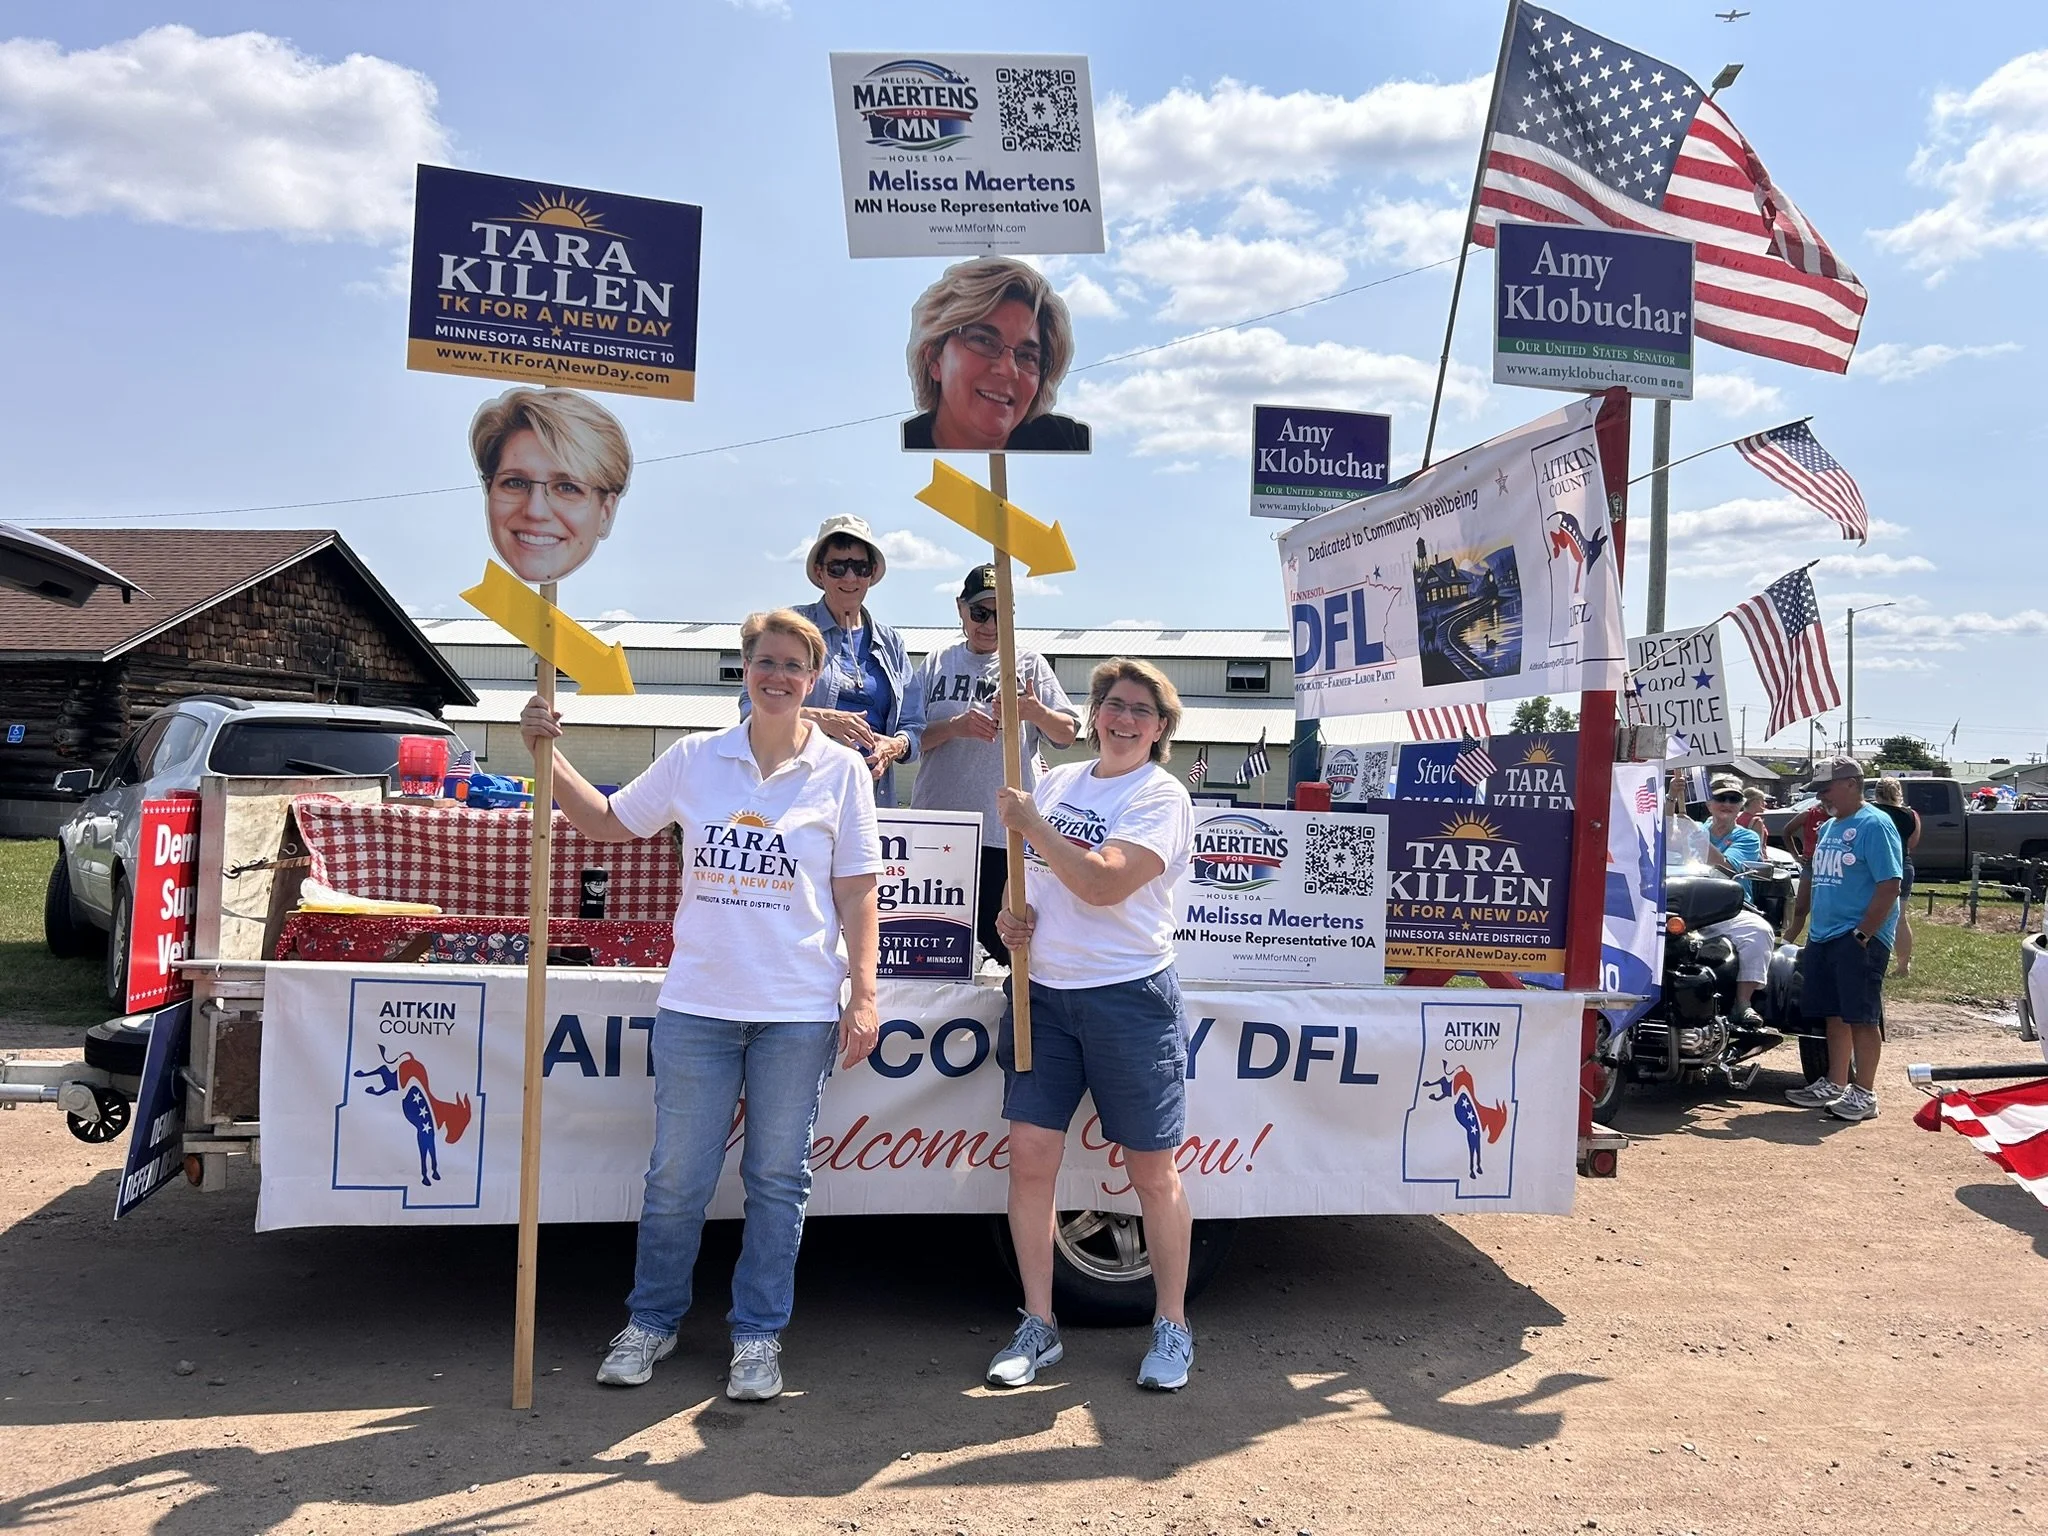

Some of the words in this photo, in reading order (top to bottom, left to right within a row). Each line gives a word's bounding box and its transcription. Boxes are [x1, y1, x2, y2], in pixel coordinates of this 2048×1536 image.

[881, 77, 924, 85] MELISSA
[853, 84, 979, 110] MAERTENS
[897, 118, 941, 139] MN
[869, 169, 958, 192] Melissa
[965, 170, 1075, 192] Maertens
[854, 199, 883, 213] MN
[887, 199, 937, 213] House
[941, 199, 1059, 216] Representative
[1062, 199, 1092, 213] 10A
[929, 223, 1027, 234] www.MMforMN.com
[472, 222, 637, 274] TARA
[1531, 241, 1613, 292] Amy
[438, 254, 674, 317] KILLEN
[438, 294, 470, 313] TK
[480, 299, 528, 320] FOR
[537, 308, 552, 322] A
[563, 310, 617, 331] NEW
[627, 318, 672, 337] DAY
[1504, 284, 1687, 335] Klobuchar
[435, 325, 527, 346] MINNESOTA
[532, 336, 589, 354] SENATE
[593, 343, 657, 362] DISTRICT
[661, 352, 674, 363] 10
[1516, 340, 1540, 354] OUR
[1545, 342, 1586, 356] UNITED
[1592, 346, 1628, 360] STATES
[1633, 350, 1675, 366] SENATOR
[437, 347, 670, 384] www.TKForANewDay.com
[1506, 365, 1658, 386] www.amyklobuchar.com
[1277, 417, 1334, 452] Amy
[1258, 447, 1385, 480] Klobuchar
[1266, 486, 1283, 495] OUR
[1286, 487, 1314, 496] UNITED
[1319, 488, 1343, 498] STATES
[1308, 531, 1351, 562] Dedicated
[1353, 532, 1363, 547] to
[1363, 511, 1421, 542] Community
[1420, 488, 1478, 521] Wellbeing
[1292, 588, 1384, 675] DFL
[930, 674, 999, 703] ARM
[1648, 668, 1686, 692] and
[1687, 732, 1728, 757] ALL
[1325, 763, 1359, 777] MAERTENS
[1414, 757, 1456, 784] Steve
[1505, 768, 1566, 793] TARA
[704, 825, 787, 854] TARA
[1041, 814, 1107, 845] ERTENS
[155, 823, 198, 866] Dem
[694, 847, 798, 879] KILLEN
[1406, 842, 1524, 873] TARA
[694, 871, 707, 881] TK
[707, 873, 724, 883] FOR
[728, 875, 736, 885] A
[740, 876, 768, 888] NEW
[772, 879, 794, 891] DAY
[886, 865, 905, 877] as
[1216, 863, 1253, 880] MN
[877, 878, 966, 911] ghlin
[1387, 870, 1552, 907] KILLEN
[160, 878, 196, 925] Sup
[721, 898, 748, 907] SENATE
[750, 900, 781, 910] DISTRICT
[1411, 904, 1445, 919] FOR
[1452, 907, 1464, 919] A
[1470, 908, 1510, 922] NEW
[1517, 910, 1549, 923] DAY
[1187, 905, 1262, 926] Melissa
[1268, 908, 1364, 930] Maertens
[945, 937, 955, 949] 7
[1173, 929, 1196, 942] MN
[1200, 930, 1241, 943] House
[1245, 931, 1347, 948] Representative
[1351, 935, 1376, 949] 10A
[1448, 931, 1489, 942] SENATE
[1492, 934, 1538, 945] DISTRICT
[1540, 935, 1550, 944] 10
[157, 931, 191, 976] Vet
[886, 949, 910, 965] ALL
[926, 956, 963, 964] MINNESOTA
[1233, 953, 1317, 963] www.MMforMN.com
[379, 1001, 456, 1020] AITKIN
[380, 1020, 455, 1036] COUNTY
[1444, 1021, 1500, 1037] AITKIN
[1236, 1020, 1379, 1085] DFL
[1445, 1039, 1498, 1051] COUNTY
[123, 1156, 160, 1207] DEFEND
